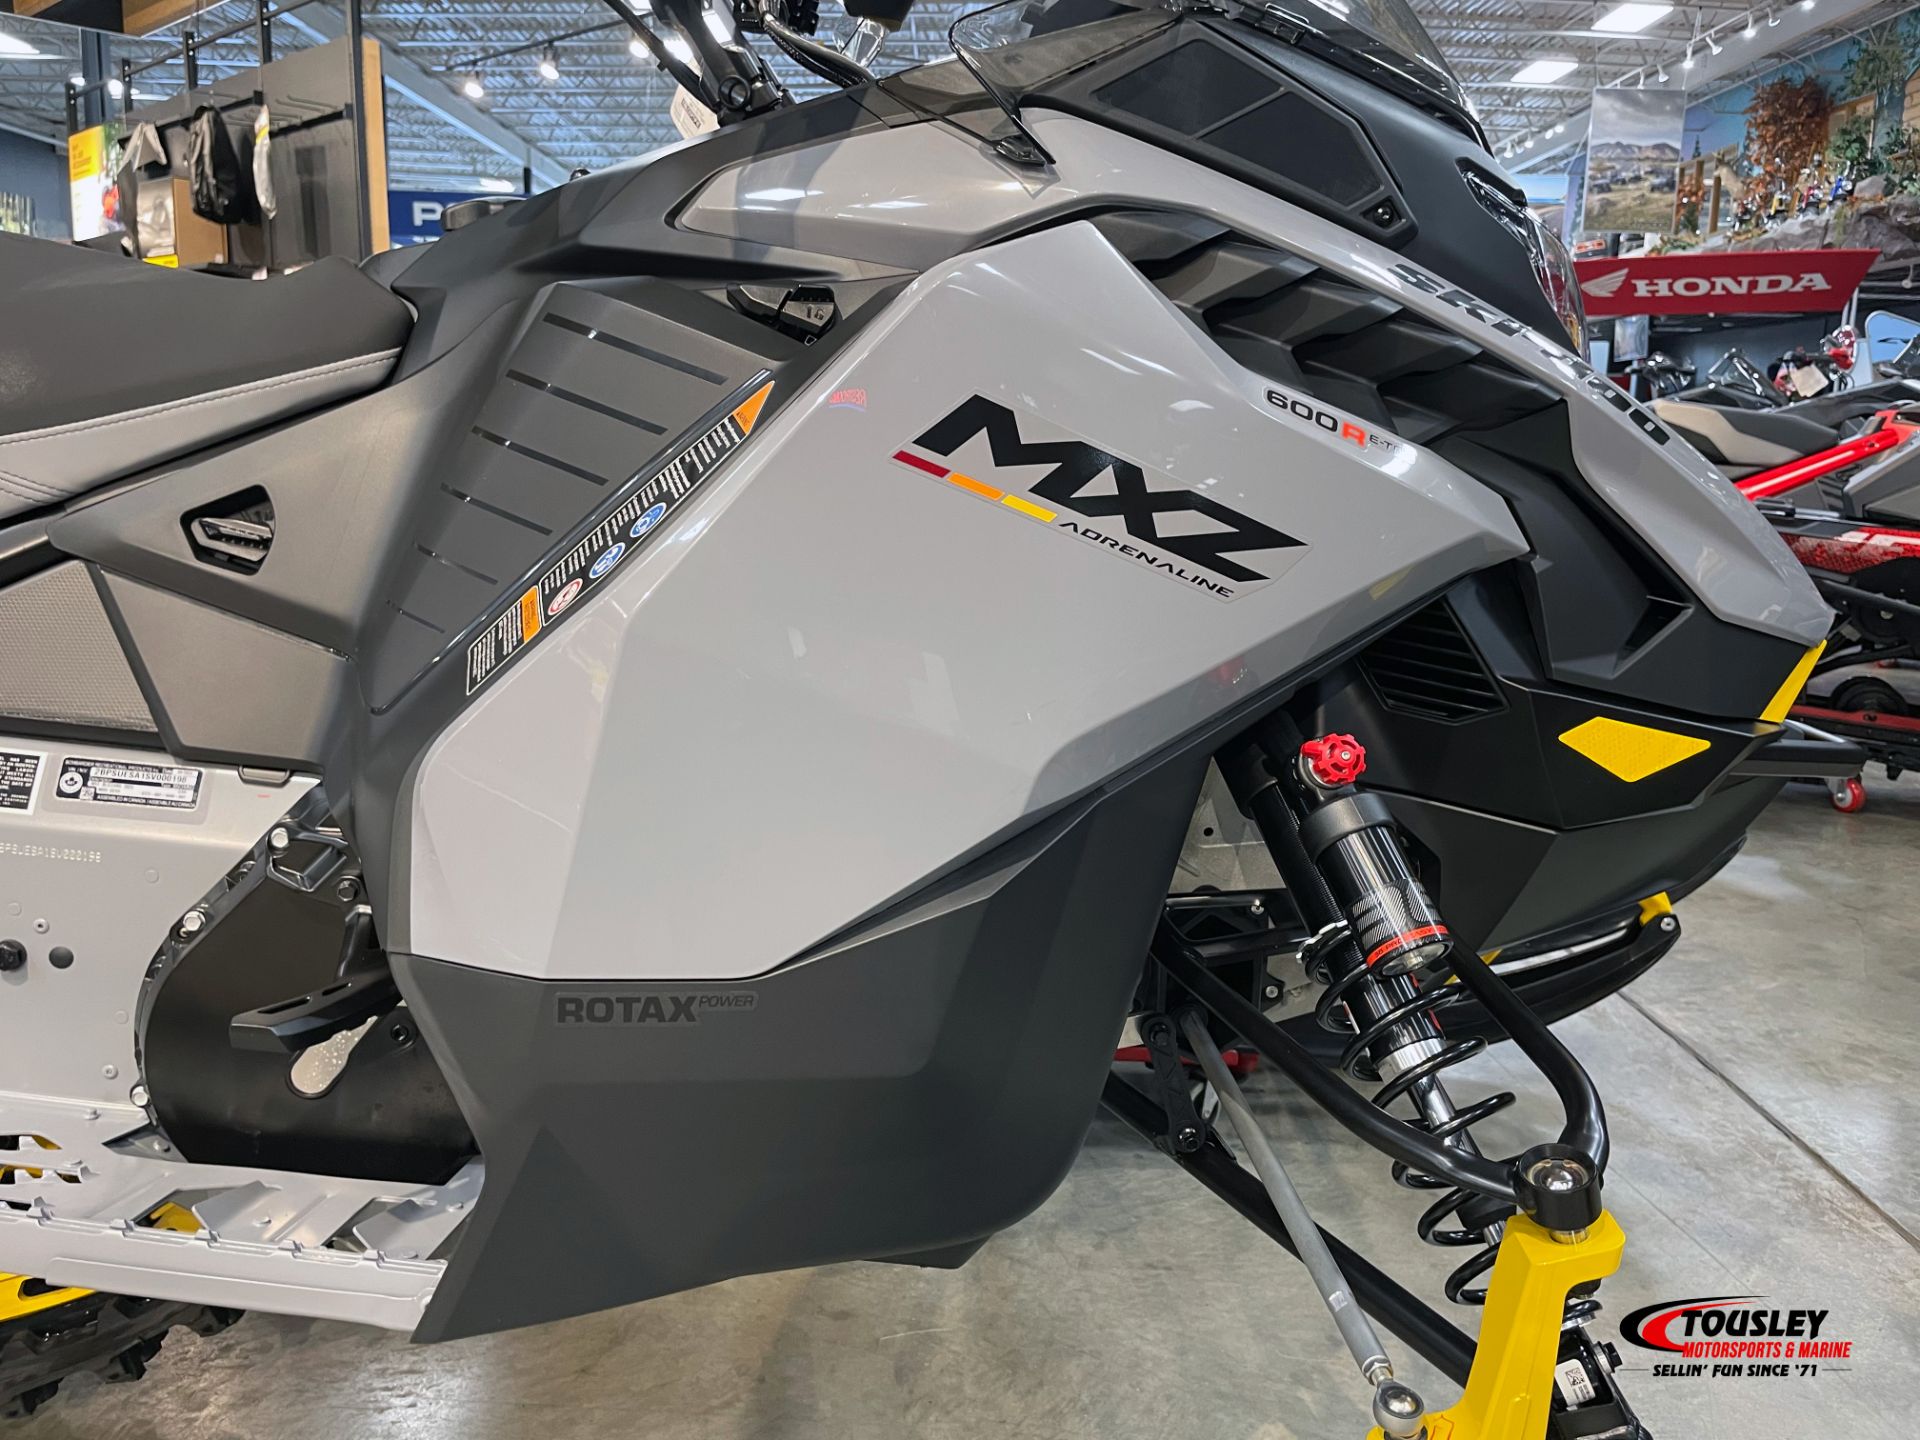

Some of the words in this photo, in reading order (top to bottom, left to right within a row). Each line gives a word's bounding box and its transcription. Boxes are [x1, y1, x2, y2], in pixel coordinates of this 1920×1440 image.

[1631, 273, 1832, 297] HONDA
[1386, 263, 1671, 447] SKIDOO
[911, 393, 1308, 583] MXZ
[1059, 522, 1235, 599] ADRENALINE
[556, 995, 698, 1024] ROTAX
[698, 994, 756, 1009] POWER
